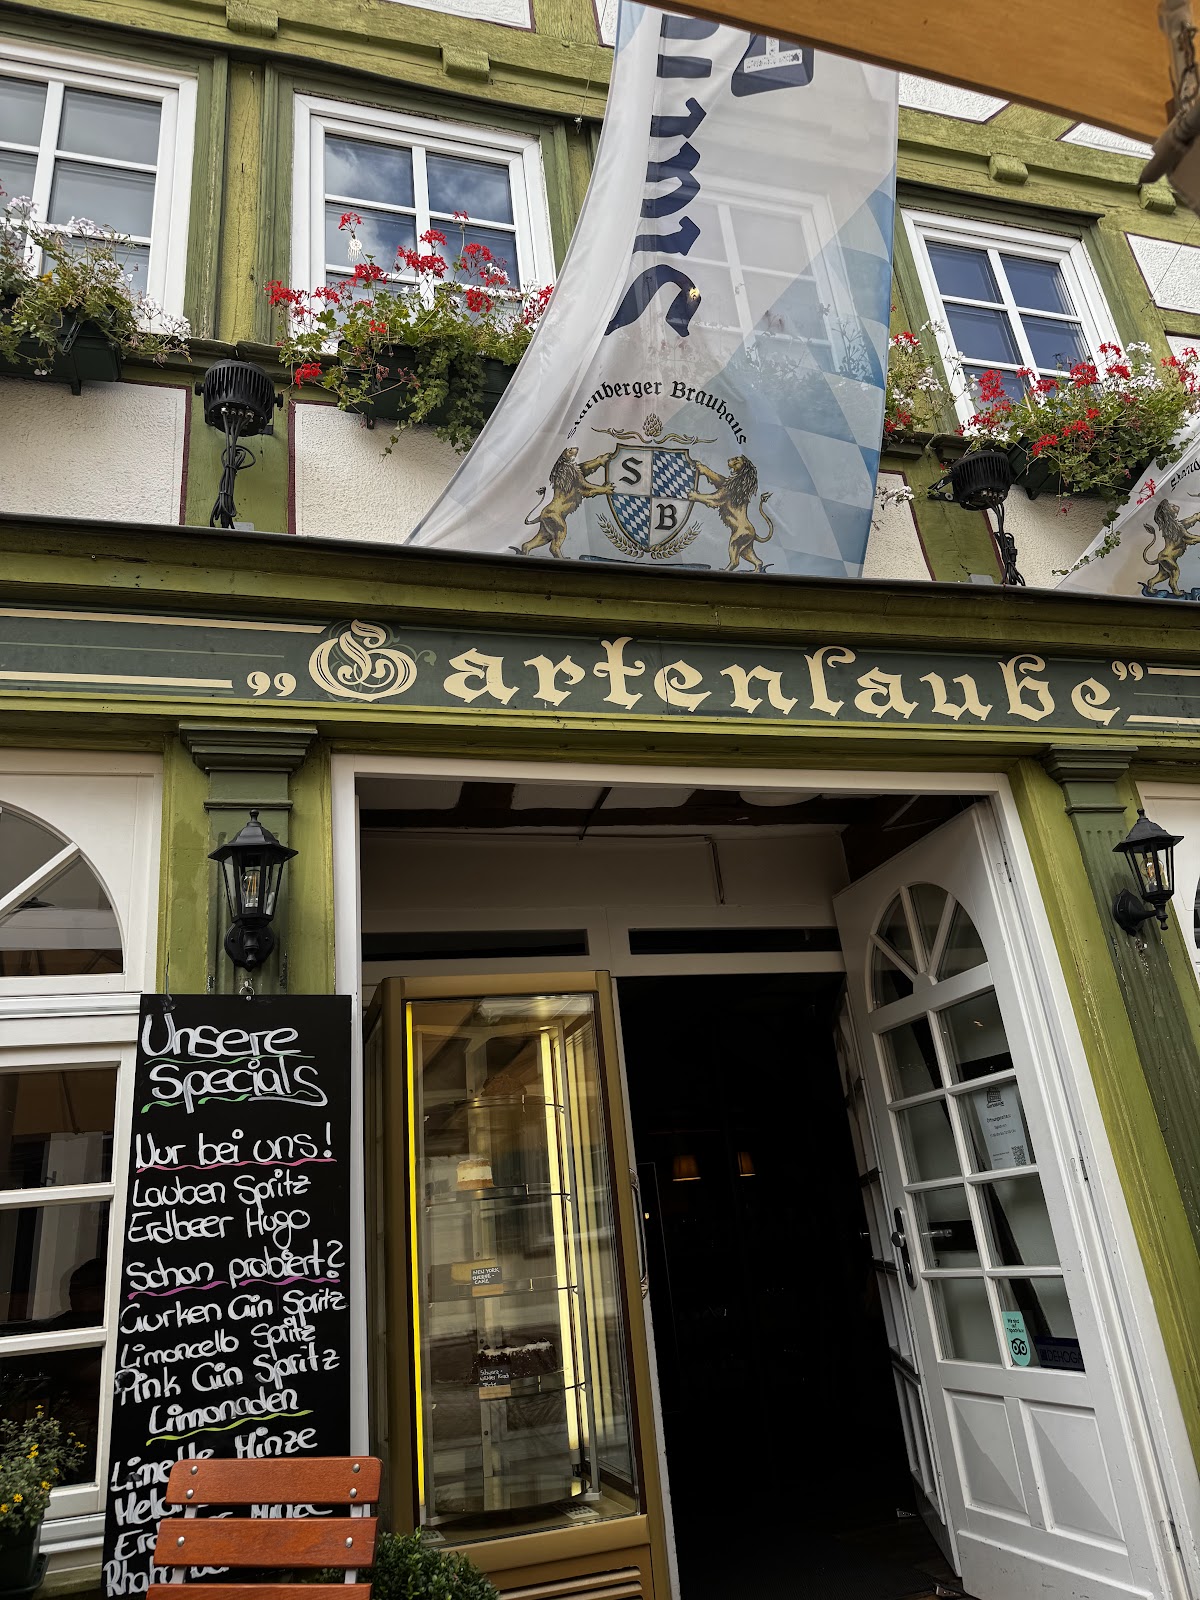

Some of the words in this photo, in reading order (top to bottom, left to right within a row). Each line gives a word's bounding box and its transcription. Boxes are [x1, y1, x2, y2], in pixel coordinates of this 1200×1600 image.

[567, 381, 663, 440] Starnberger
[670, 380, 748, 445] Brauhaus
[618, 456, 644, 486] S
[654, 503, 679, 531] B
[141, 1012, 302, 1057] Unsere
[149, 1056, 329, 1114] Specials
[135, 1132, 187, 1169] Nur
[198, 1128, 245, 1166] bei
[252, 1121, 334, 1163] uns!
[132, 1176, 226, 1208] Lauben
[233, 1168, 312, 1212] Spritz
[127, 1208, 235, 1244] Erdbeer
[246, 1207, 311, 1250] Hugo
[126, 1256, 215, 1291] Schon
[229, 1238, 346, 1289] probiert?
[119, 1300, 222, 1334] Gurken
[227, 1293, 274, 1321] Gin
[282, 1287, 348, 1327] Spritz
[120, 1328, 240, 1369] Limoncello
[250, 1315, 317, 1360] Spritz
[114, 1366, 182, 1406] Pink
[192, 1361, 244, 1392] Gin
[252, 1342, 341, 1391] Spritz
[148, 1385, 299, 1434] Limonaden
[234, 1426, 318, 1459] Minze
